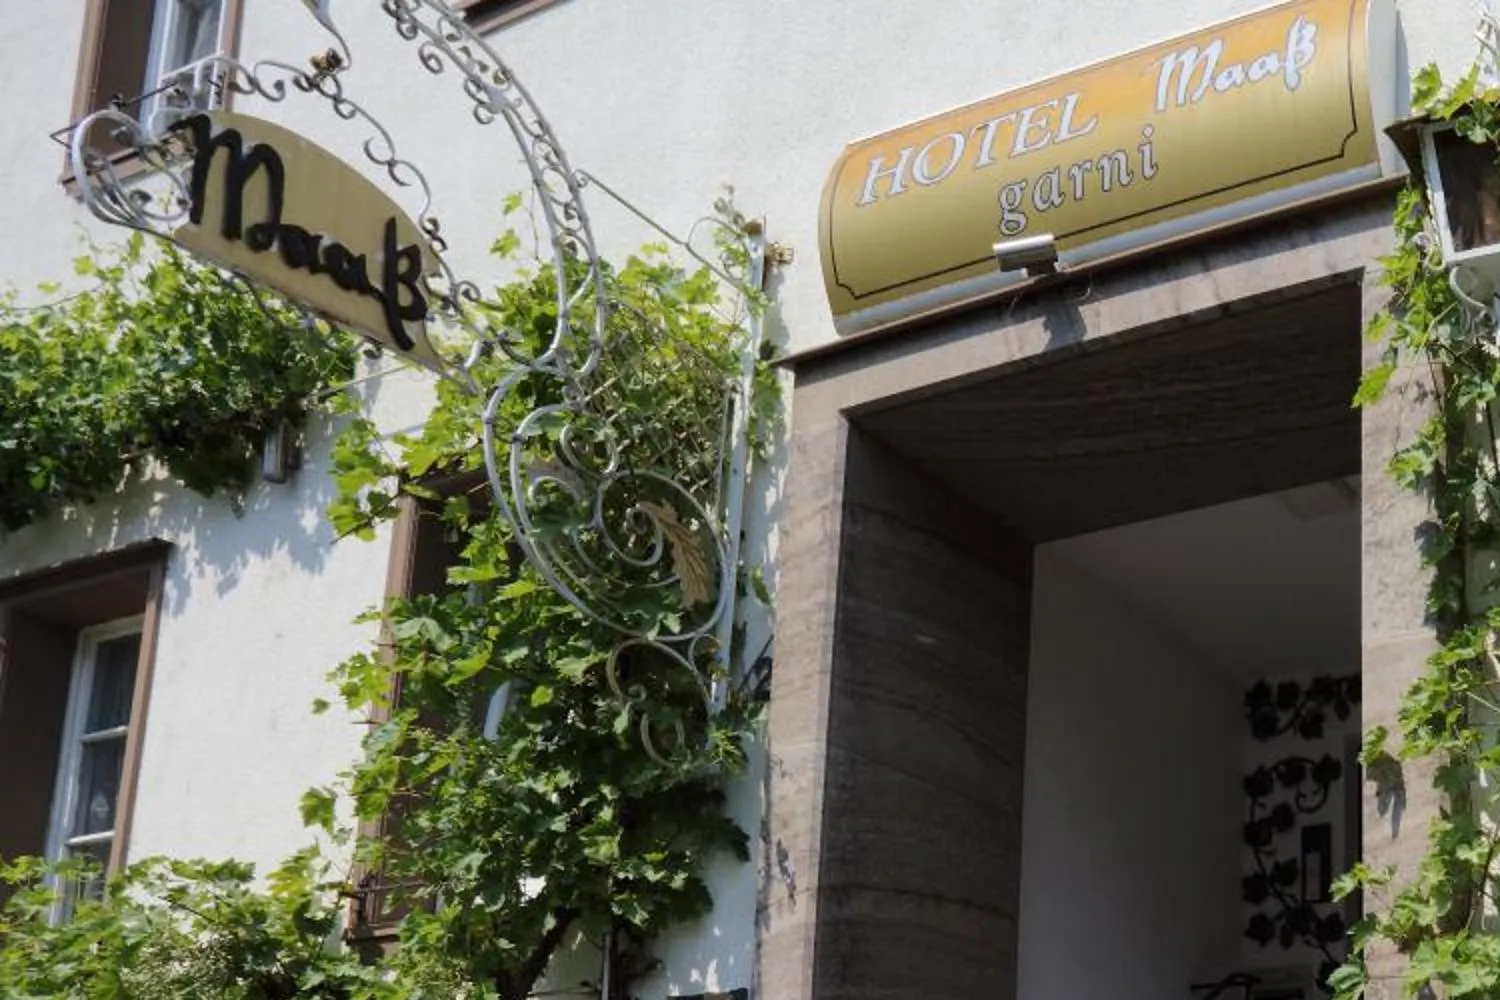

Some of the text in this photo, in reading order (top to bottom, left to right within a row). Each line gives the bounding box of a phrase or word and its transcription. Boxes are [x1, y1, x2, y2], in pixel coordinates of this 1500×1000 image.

[856, 14, 1317, 207] HOTEL Maaß
[998, 124, 1159, 236] garni
[169, 114, 428, 351] Maaß
